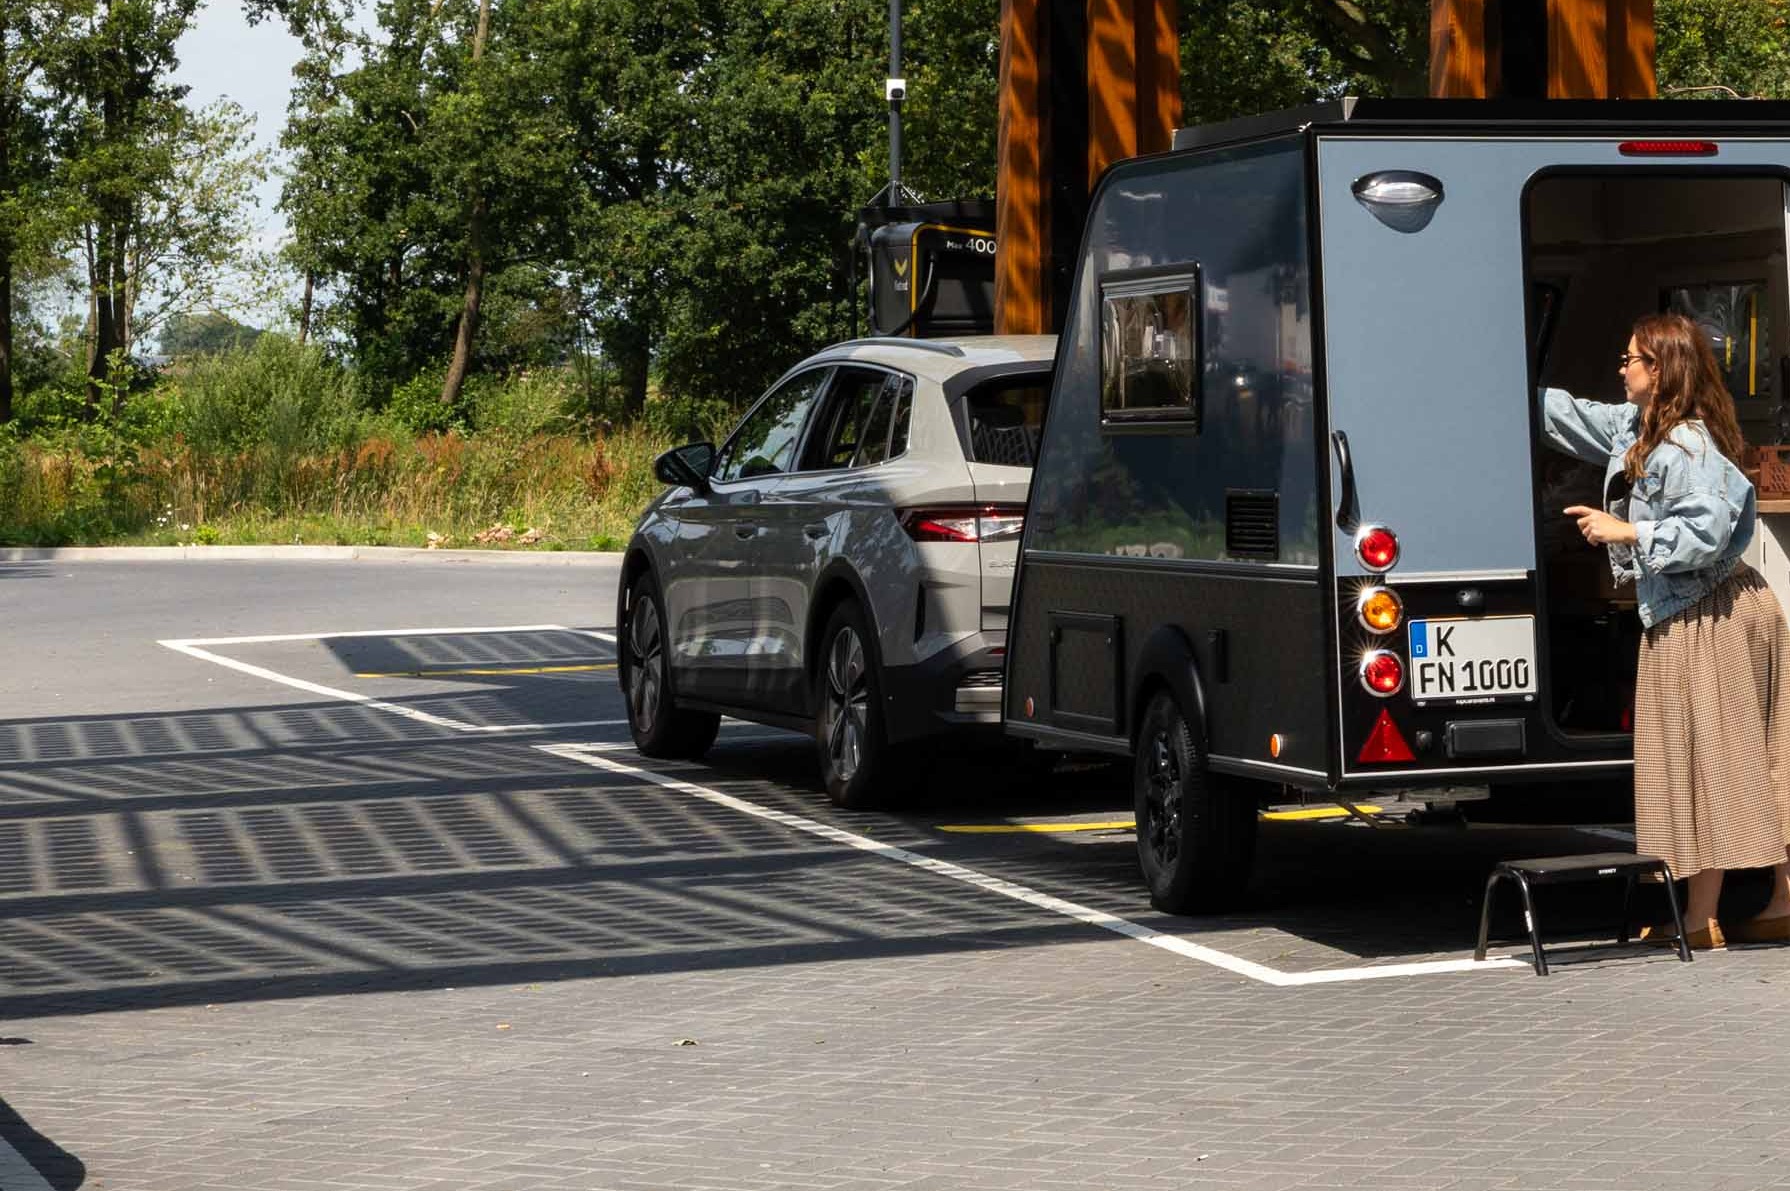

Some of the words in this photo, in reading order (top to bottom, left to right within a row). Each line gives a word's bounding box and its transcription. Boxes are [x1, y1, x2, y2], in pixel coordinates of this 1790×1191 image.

[965, 238, 997, 255] 400
[1416, 644, 1424, 654] D
[1436, 626, 1456, 657] K
